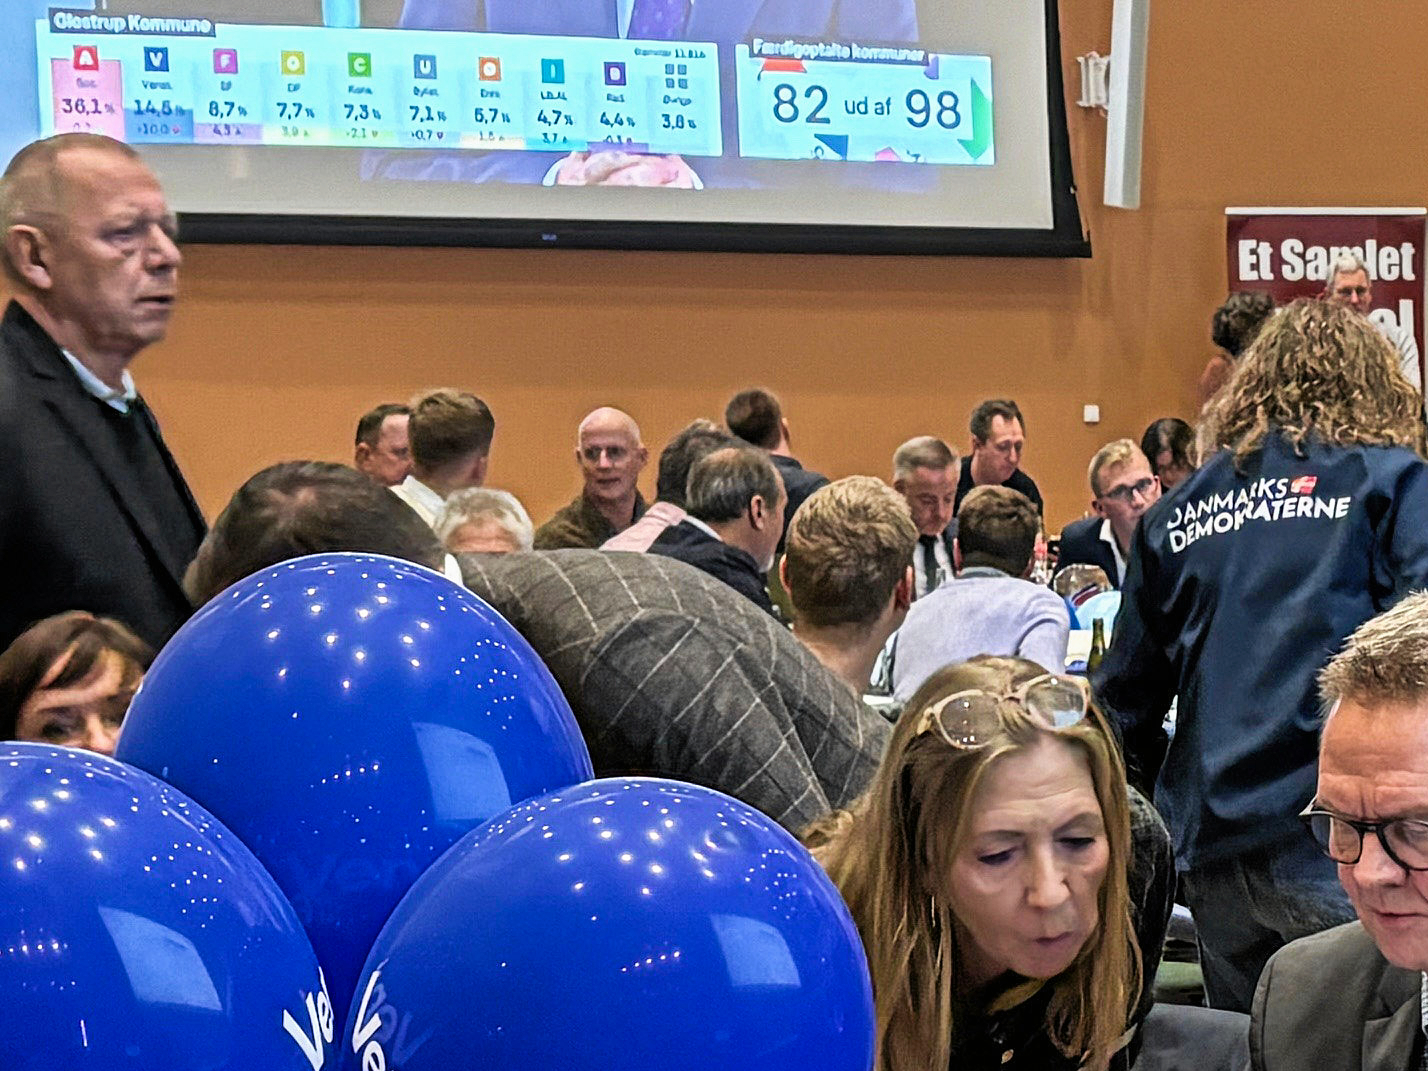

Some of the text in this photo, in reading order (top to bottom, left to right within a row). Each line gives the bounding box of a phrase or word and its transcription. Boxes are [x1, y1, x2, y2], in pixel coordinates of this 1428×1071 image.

[277, 102, 303, 120] 7,7
[773, 83, 962, 129] 82 ud af 98
[1238, 239, 1274, 281] Et
